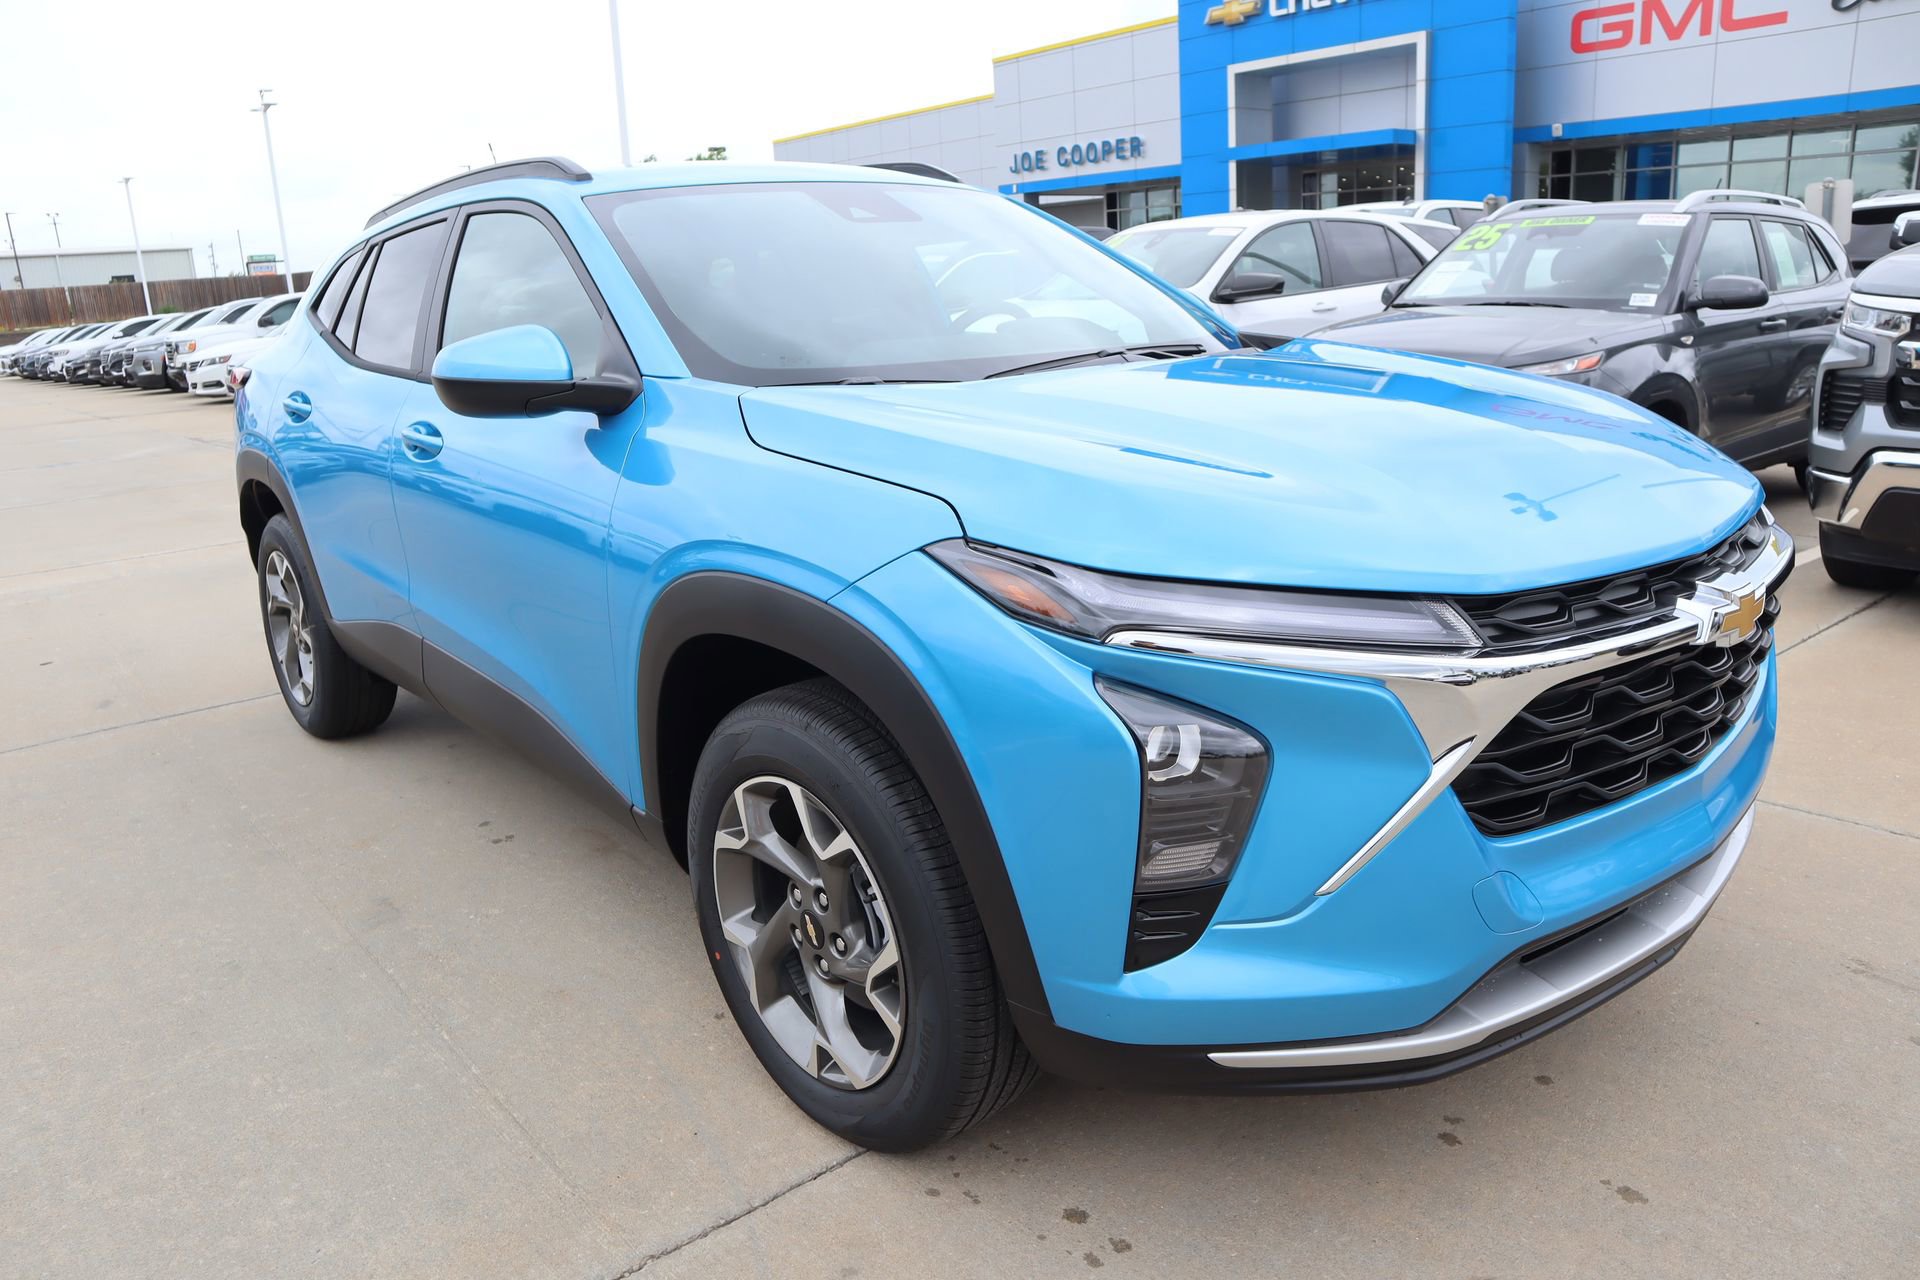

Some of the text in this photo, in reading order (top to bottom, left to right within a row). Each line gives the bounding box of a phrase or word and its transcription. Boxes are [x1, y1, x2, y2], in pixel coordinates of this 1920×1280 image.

[1570, 0, 1789, 54] GMC
[1010, 136, 1144, 174] JOE COOPER
[1455, 223, 1513, 251] 25
